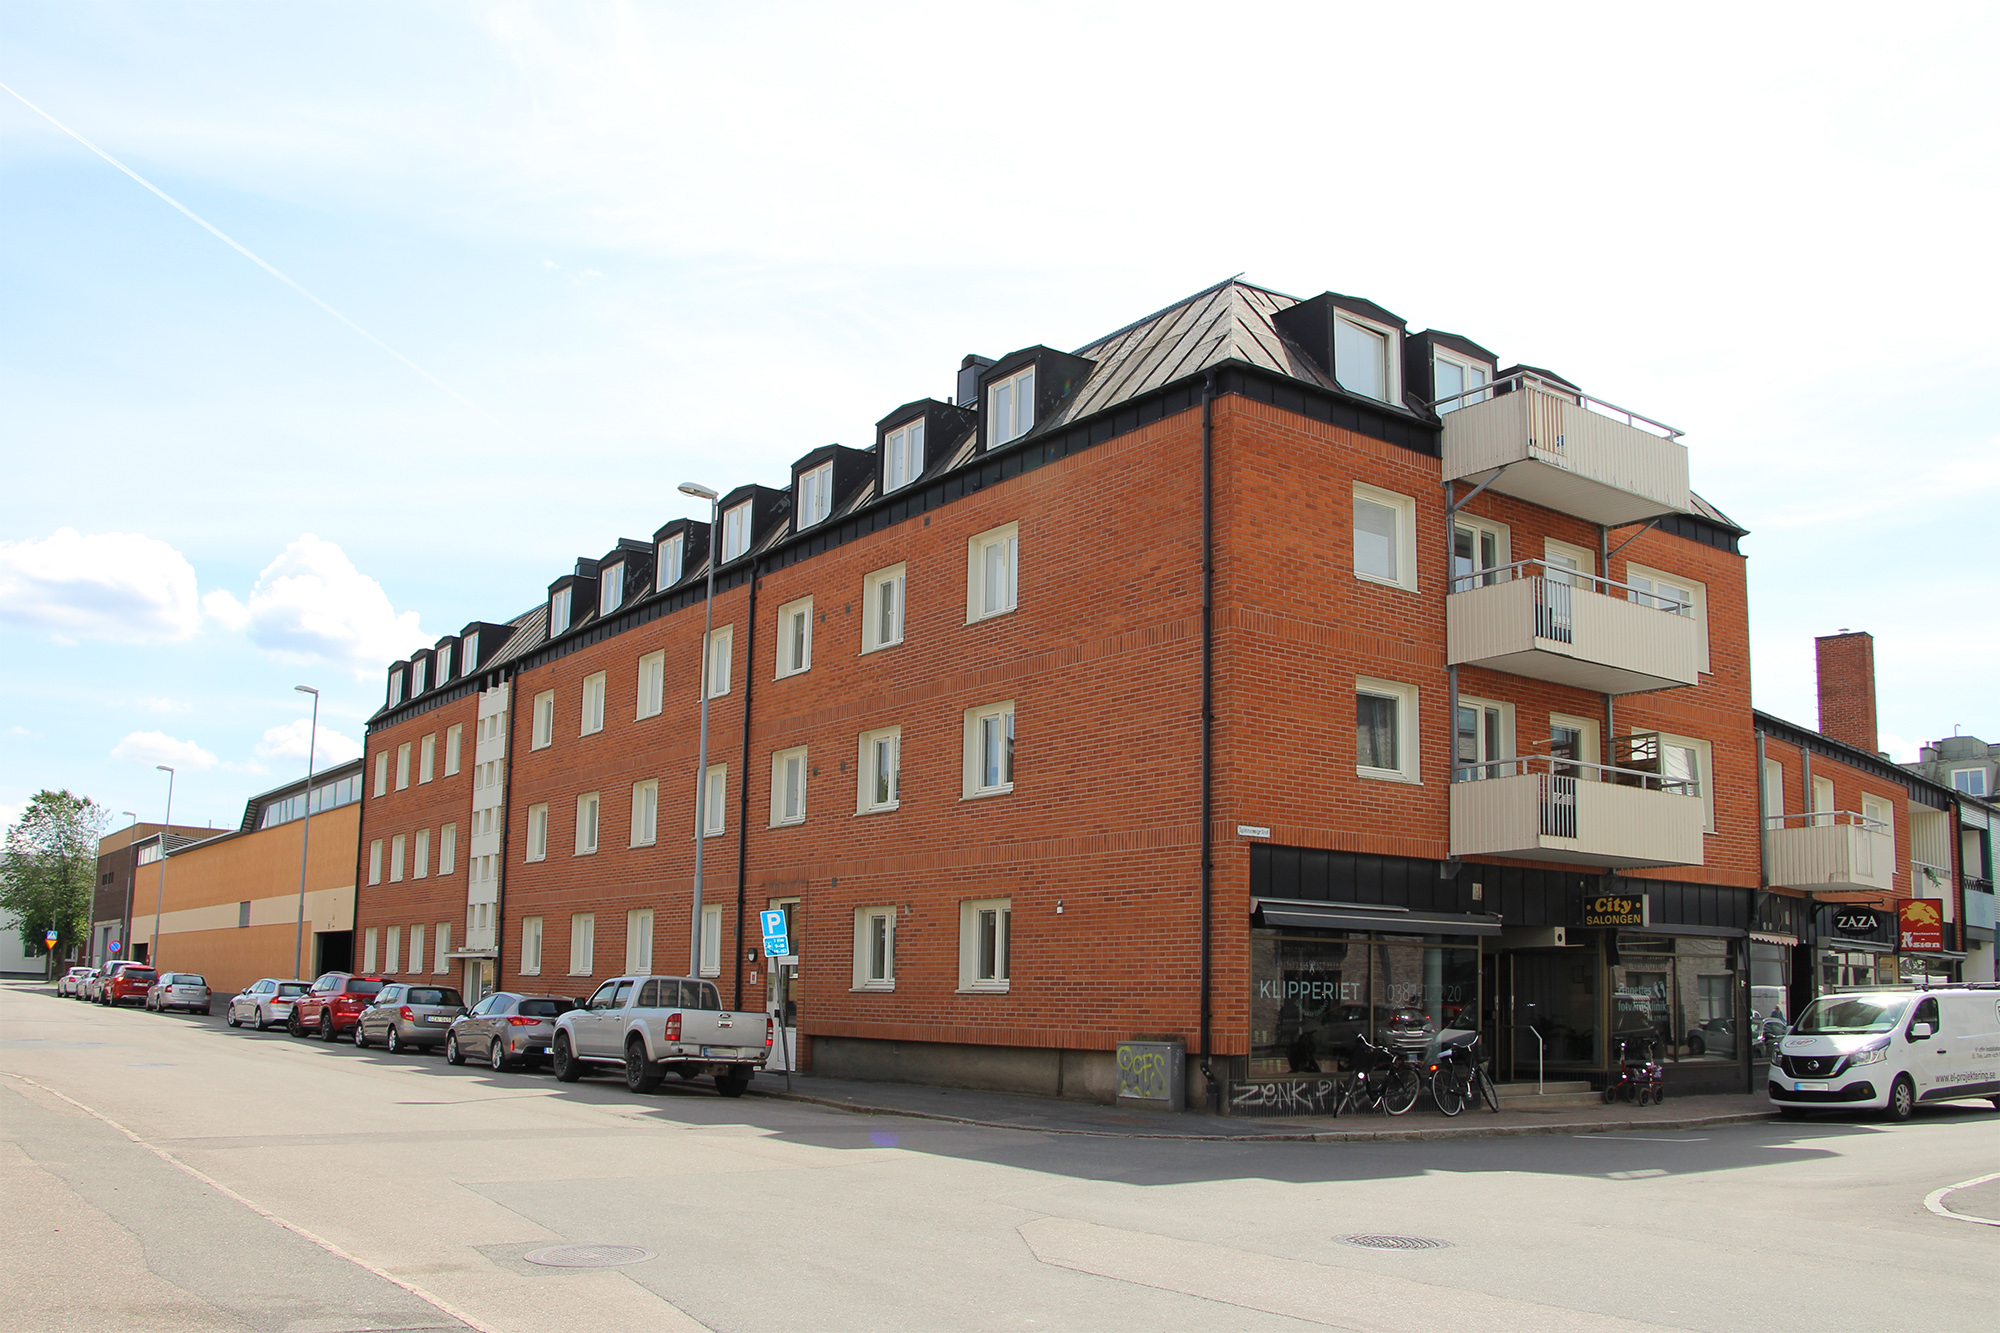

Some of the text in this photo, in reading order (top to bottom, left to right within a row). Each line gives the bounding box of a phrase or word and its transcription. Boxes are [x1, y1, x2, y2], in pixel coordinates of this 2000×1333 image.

[1595, 897, 1632, 914] City
[767, 913, 781, 934] P
[1586, 914, 1641, 925] SALONGEN
[1837, 915, 1878, 928] ZAZA
[1901, 931, 1941, 948] Asien
[1260, 980, 1360, 1000] KLIPPERIET
[1935, 1071, 1995, 1083] www.el-projektering.se
